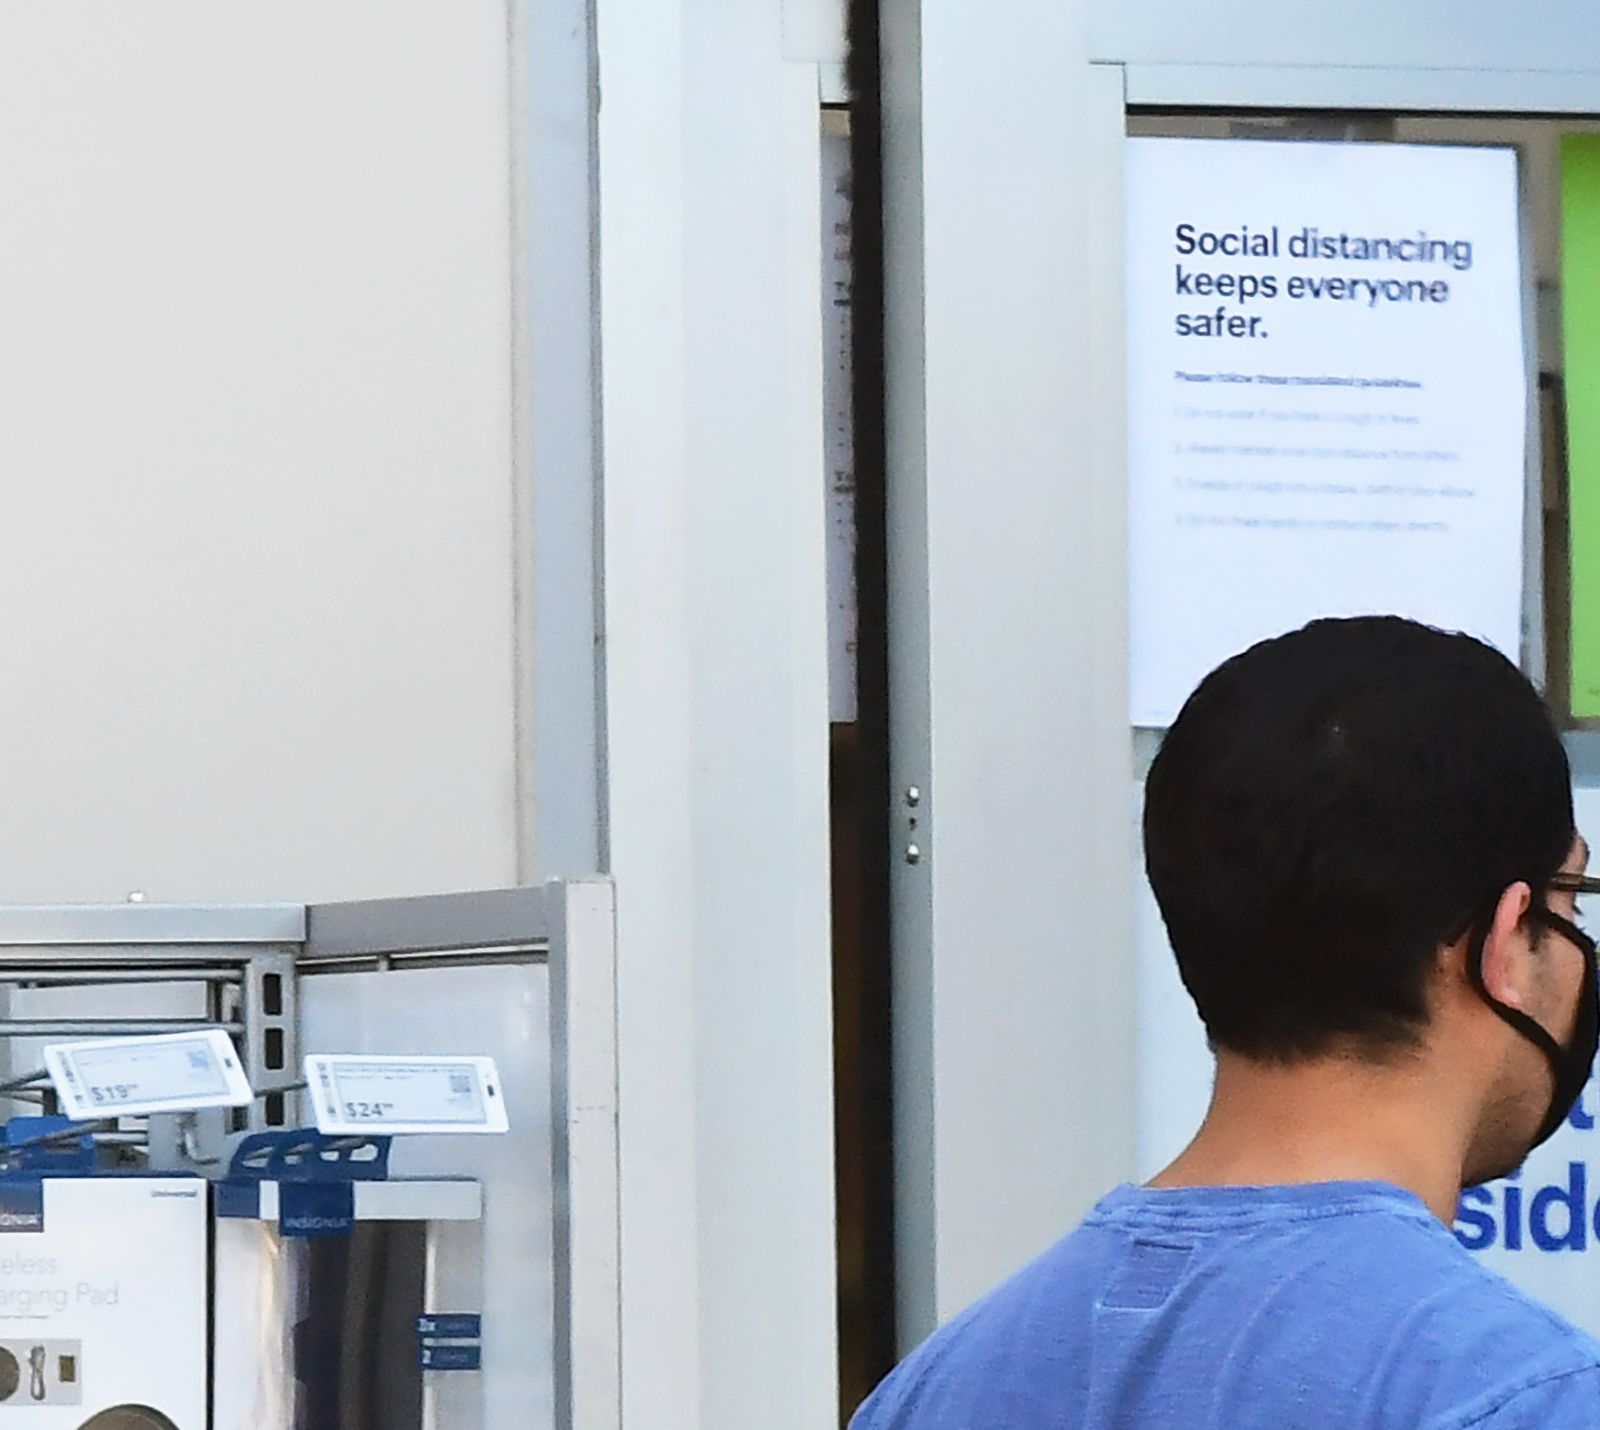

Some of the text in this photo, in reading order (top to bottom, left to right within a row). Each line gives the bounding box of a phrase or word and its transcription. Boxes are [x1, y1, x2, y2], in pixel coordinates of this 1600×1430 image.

[1175, 224, 1473, 270] Social distancing
[1175, 265, 1449, 307] keeps everyone
[1175, 308, 1269, 338] safer.
[76, 1282, 119, 1305] Pad
